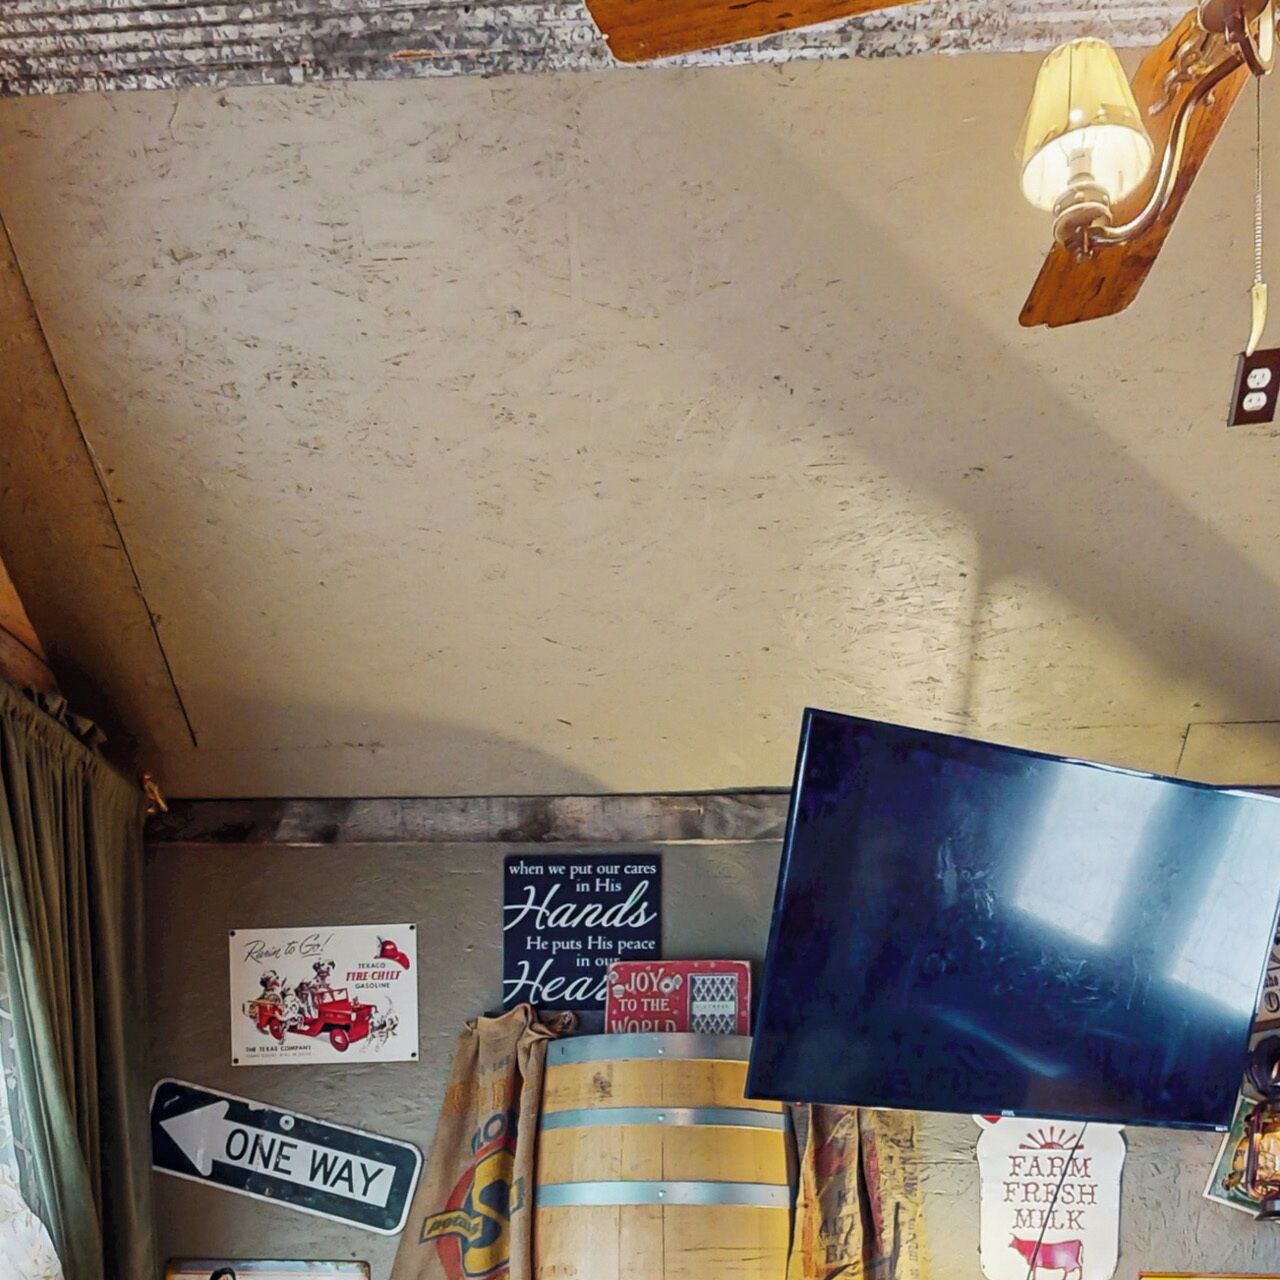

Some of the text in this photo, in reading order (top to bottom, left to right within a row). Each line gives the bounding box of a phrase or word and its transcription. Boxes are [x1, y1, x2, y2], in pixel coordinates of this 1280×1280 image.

[509, 860, 657, 880] when we put our cares
[576, 877, 622, 892] in His
[503, 880, 658, 930] Hands
[283, 940, 296, 955] to
[299, 933, 333, 957] Go!
[526, 936, 656, 955] He puts His peace
[576, 954, 620, 967] in our
[625, 968, 665, 992] JOY
[618, 998, 671, 1012] TO THE
[225, 1128, 385, 1197] ONE WAY
[1008, 1155, 1093, 1178] FARM
[1003, 1181, 1099, 1205] FRESH
[1011, 1208, 1087, 1231] MILK
